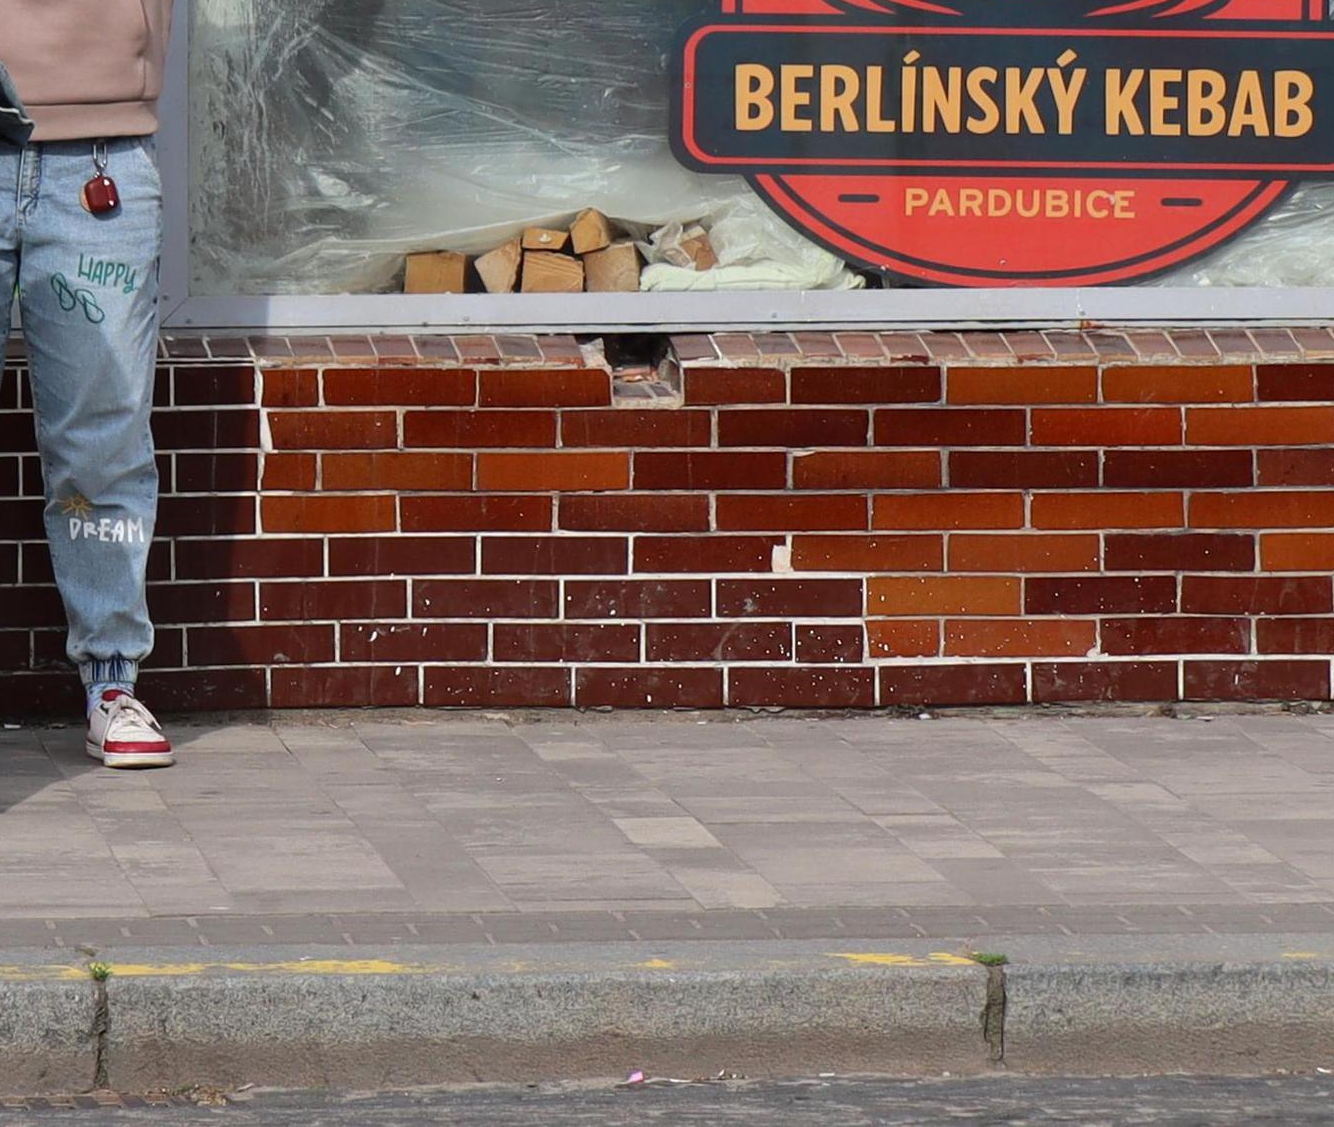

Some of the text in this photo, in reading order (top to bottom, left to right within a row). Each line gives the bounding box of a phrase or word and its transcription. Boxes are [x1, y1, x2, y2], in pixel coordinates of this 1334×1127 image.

[733, 48, 1315, 139] BERLÍNSKÝ KEBAB
[904, 188, 1137, 220] PARDUBICE
[77, 253, 137, 294] HAPPY
[69, 516, 145, 543] DREAM
